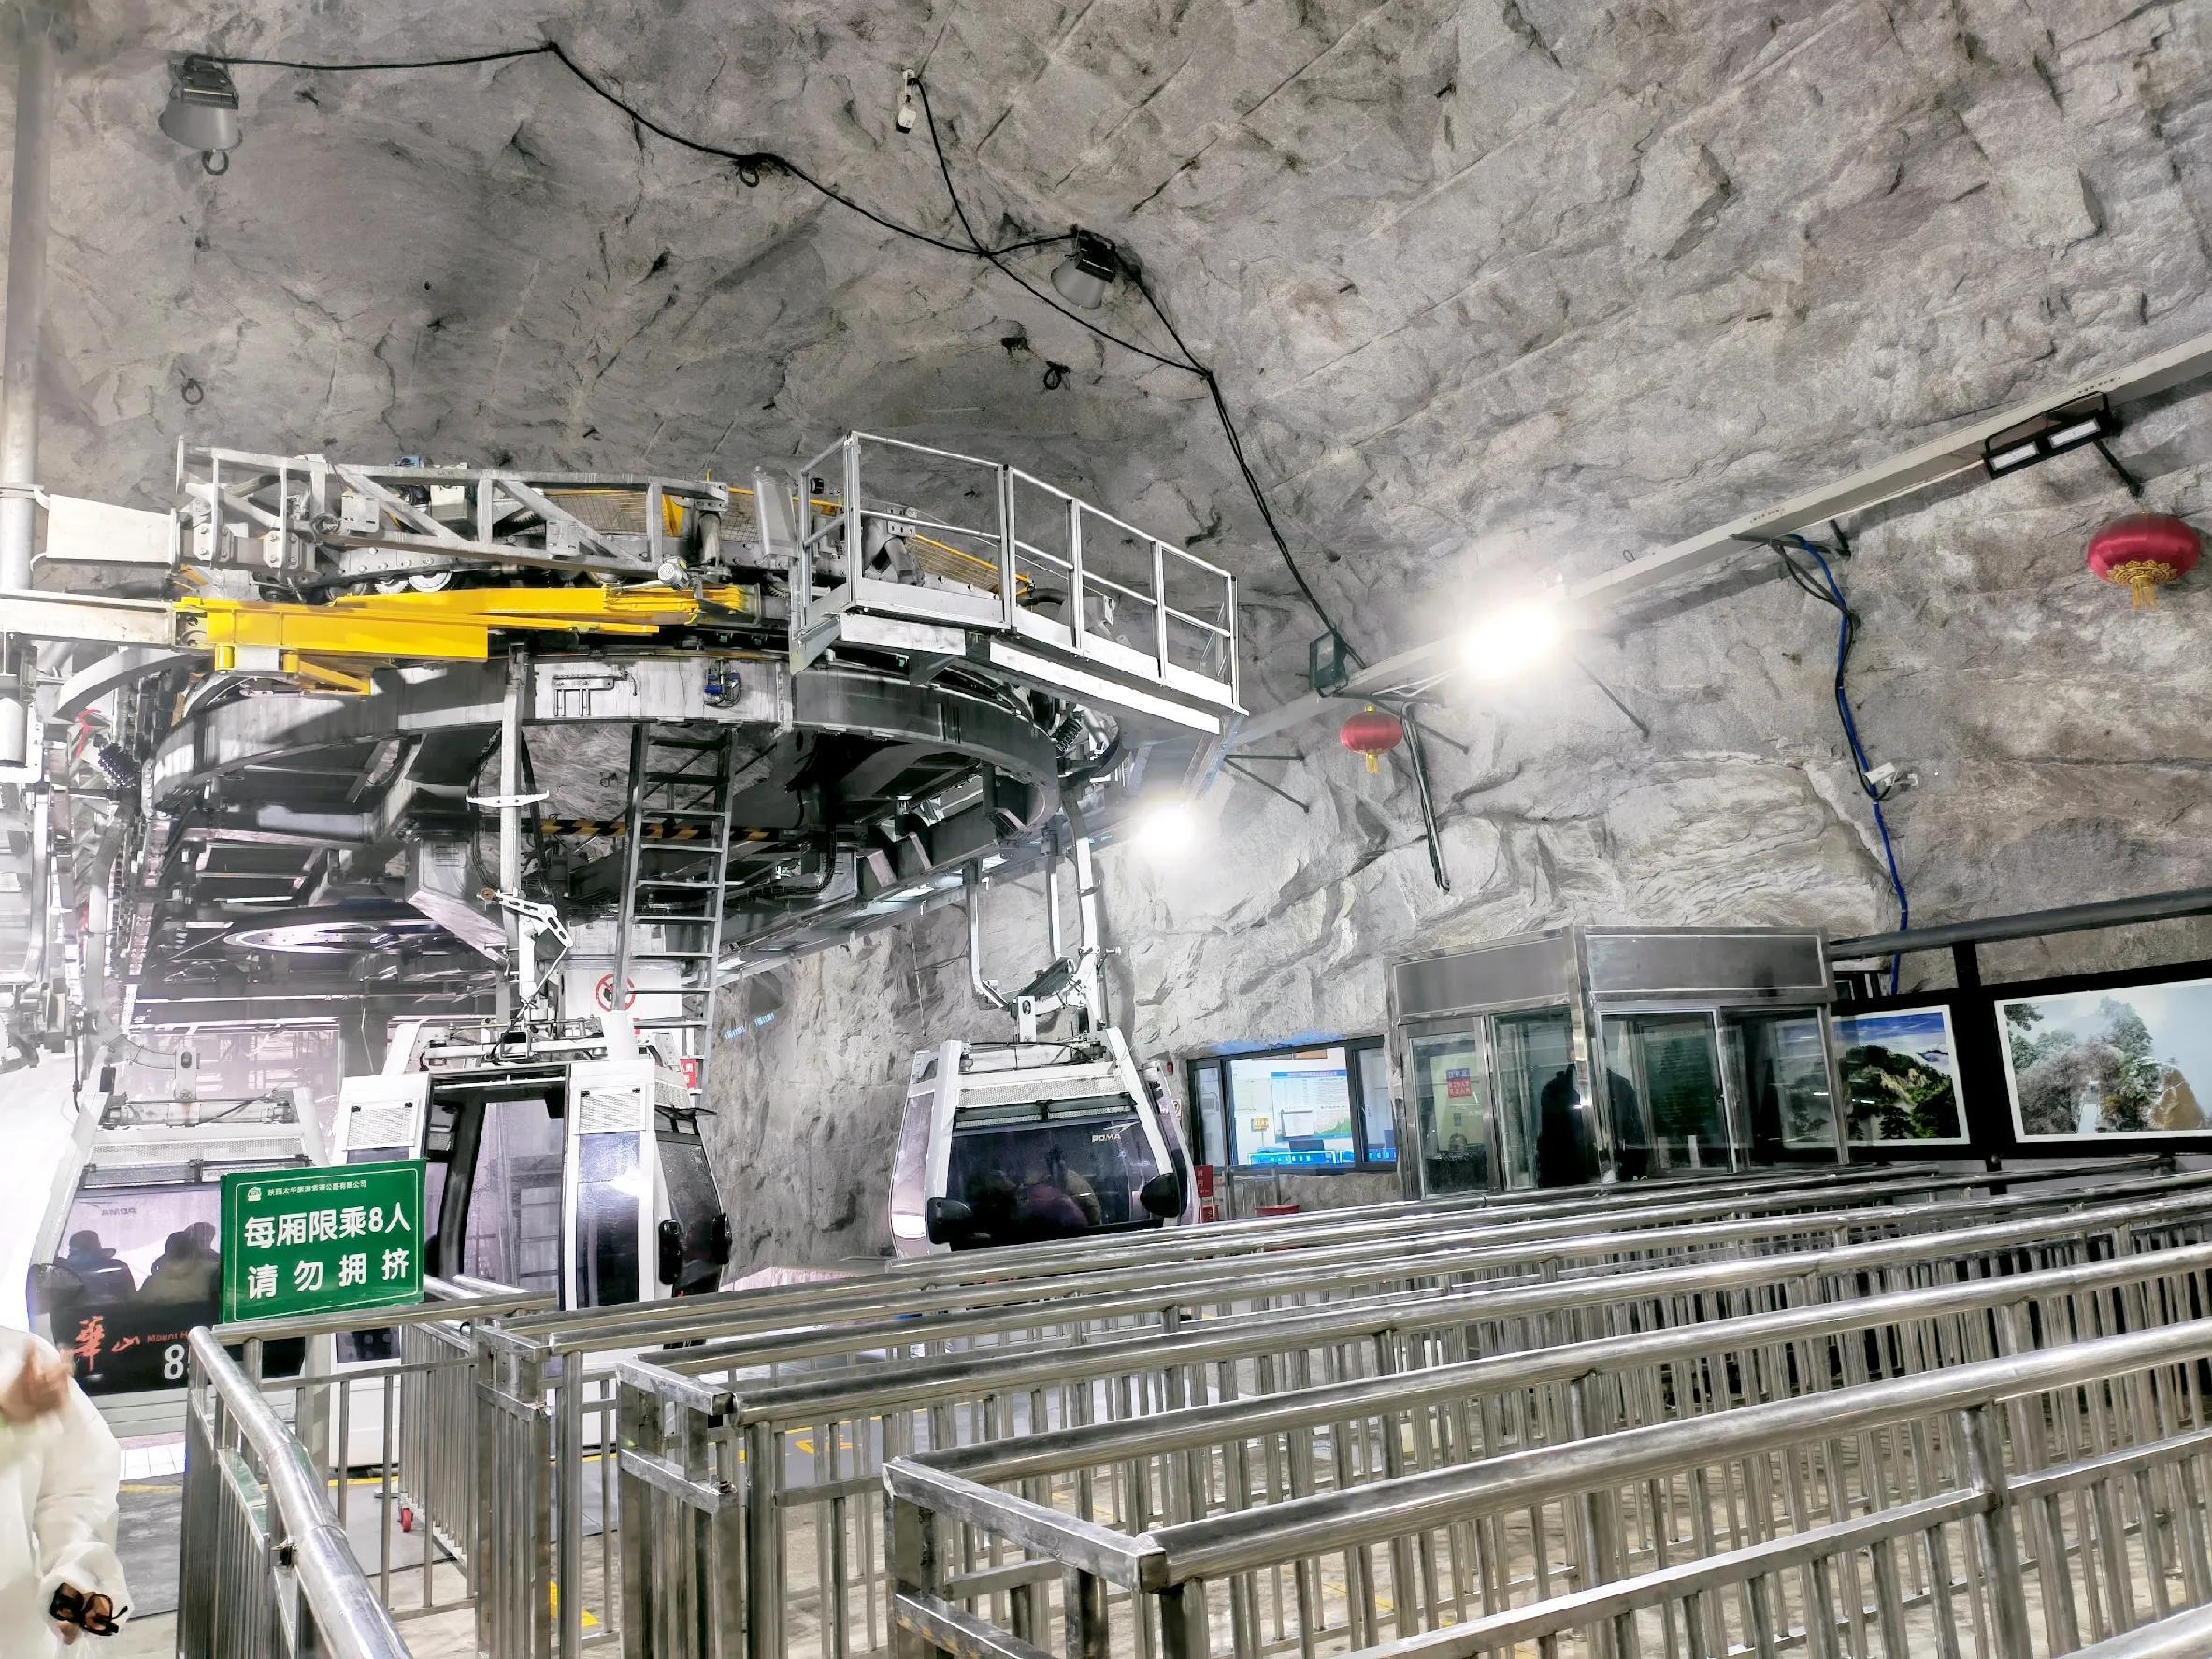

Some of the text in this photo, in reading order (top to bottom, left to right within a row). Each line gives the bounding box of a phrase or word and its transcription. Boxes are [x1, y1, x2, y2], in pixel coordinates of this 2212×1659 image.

[1092, 1133, 1122, 1142] POMA
[244, 1201, 412, 1250] 每厢限乘8人
[147, 1332, 178, 1343] Mount
